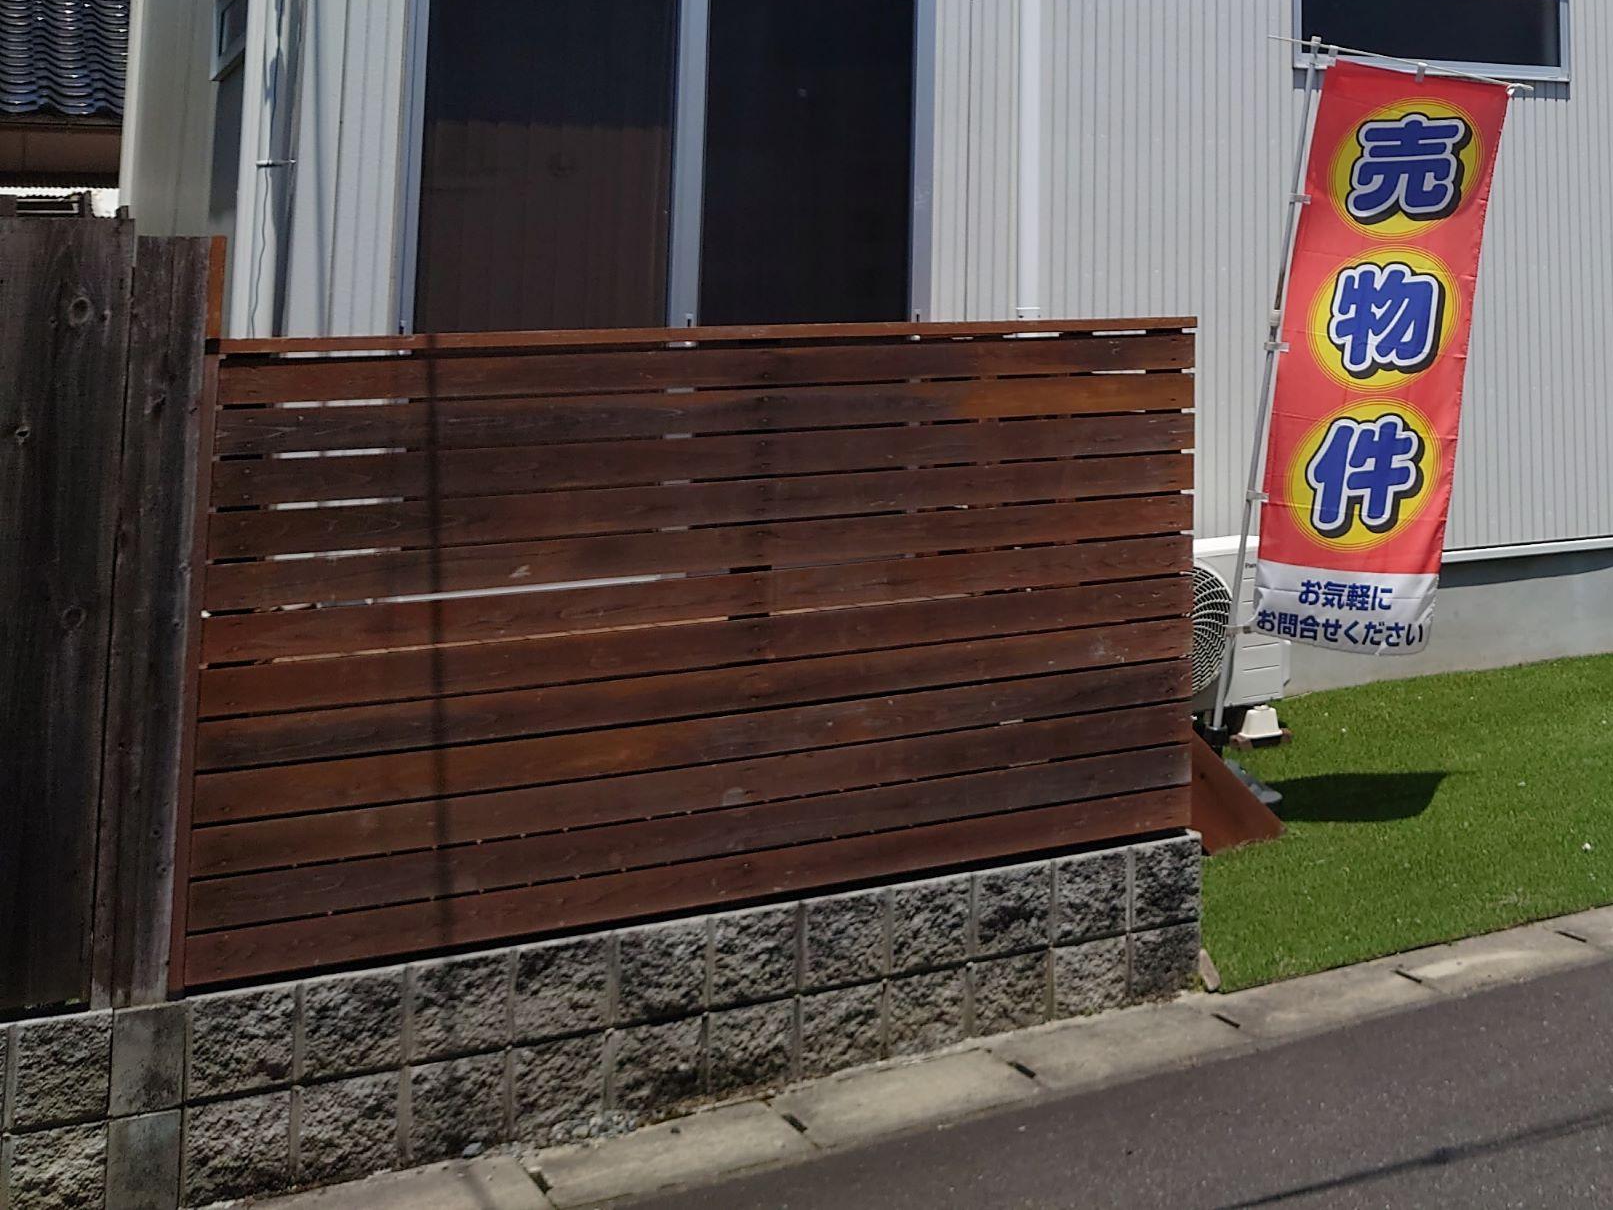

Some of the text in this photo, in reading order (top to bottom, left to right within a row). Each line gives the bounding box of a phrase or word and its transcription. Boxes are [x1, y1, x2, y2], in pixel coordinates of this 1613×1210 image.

[1306, 112, 1472, 538] 売物件
[1298, 579, 1393, 611] お気軽に
[1257, 609, 1424, 647] お問合せください
